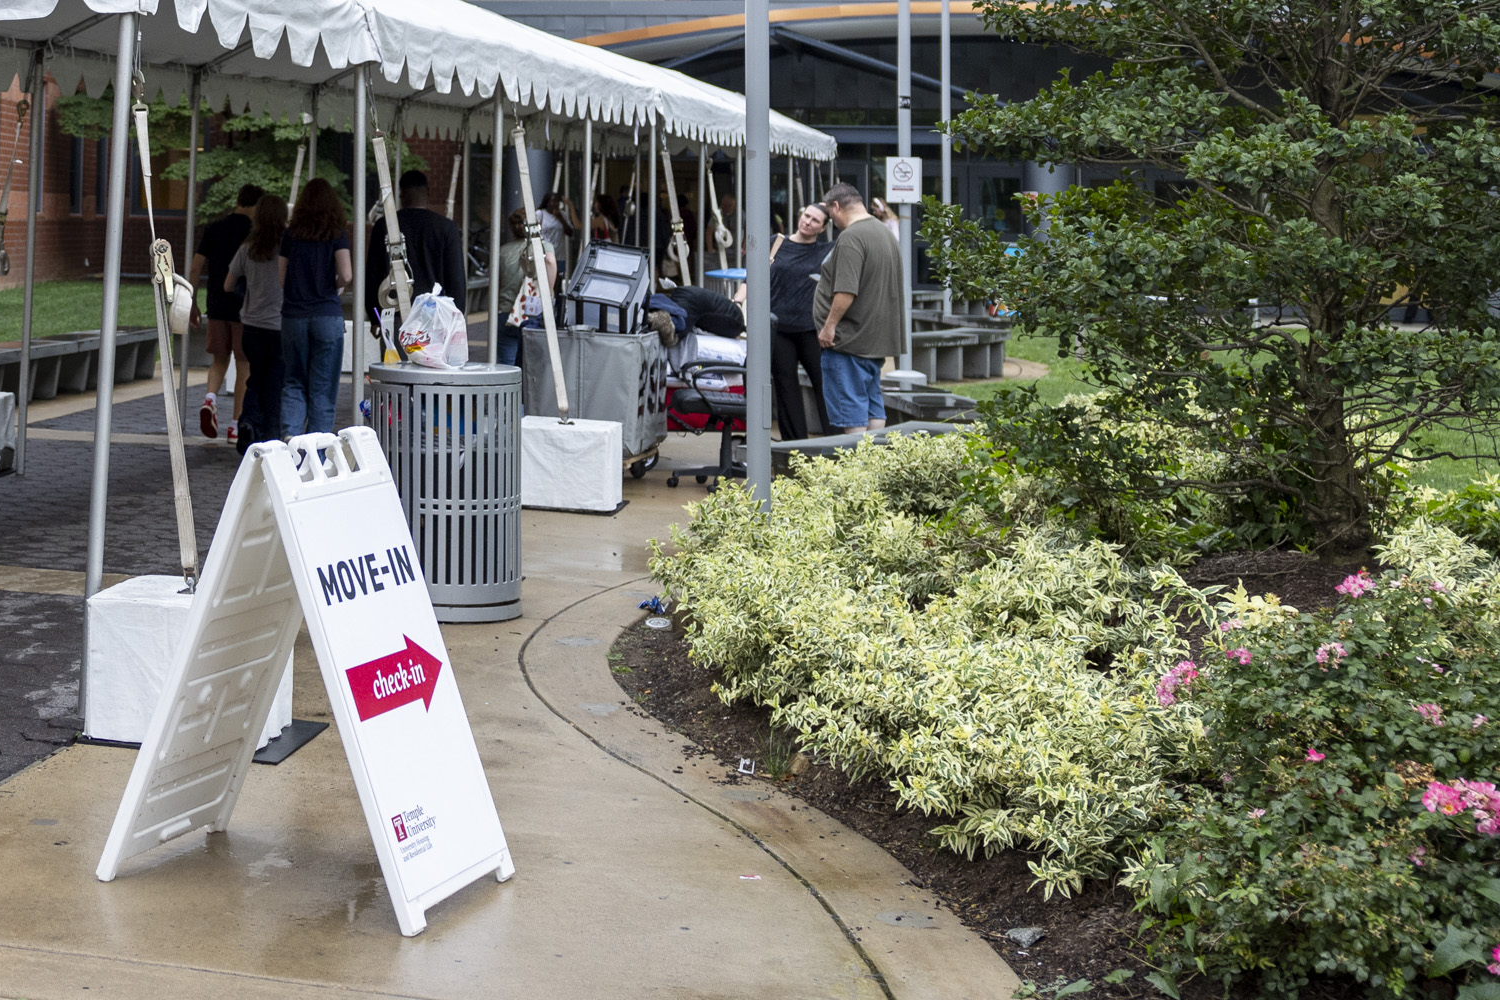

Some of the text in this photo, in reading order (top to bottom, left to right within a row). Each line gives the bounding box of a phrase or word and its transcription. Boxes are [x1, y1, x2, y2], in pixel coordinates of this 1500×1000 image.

[316, 545, 416, 606] MOVE-IN
[373, 658, 426, 700] check-in
[402, 804, 424, 823] Temple
[406, 816, 436, 837] University
